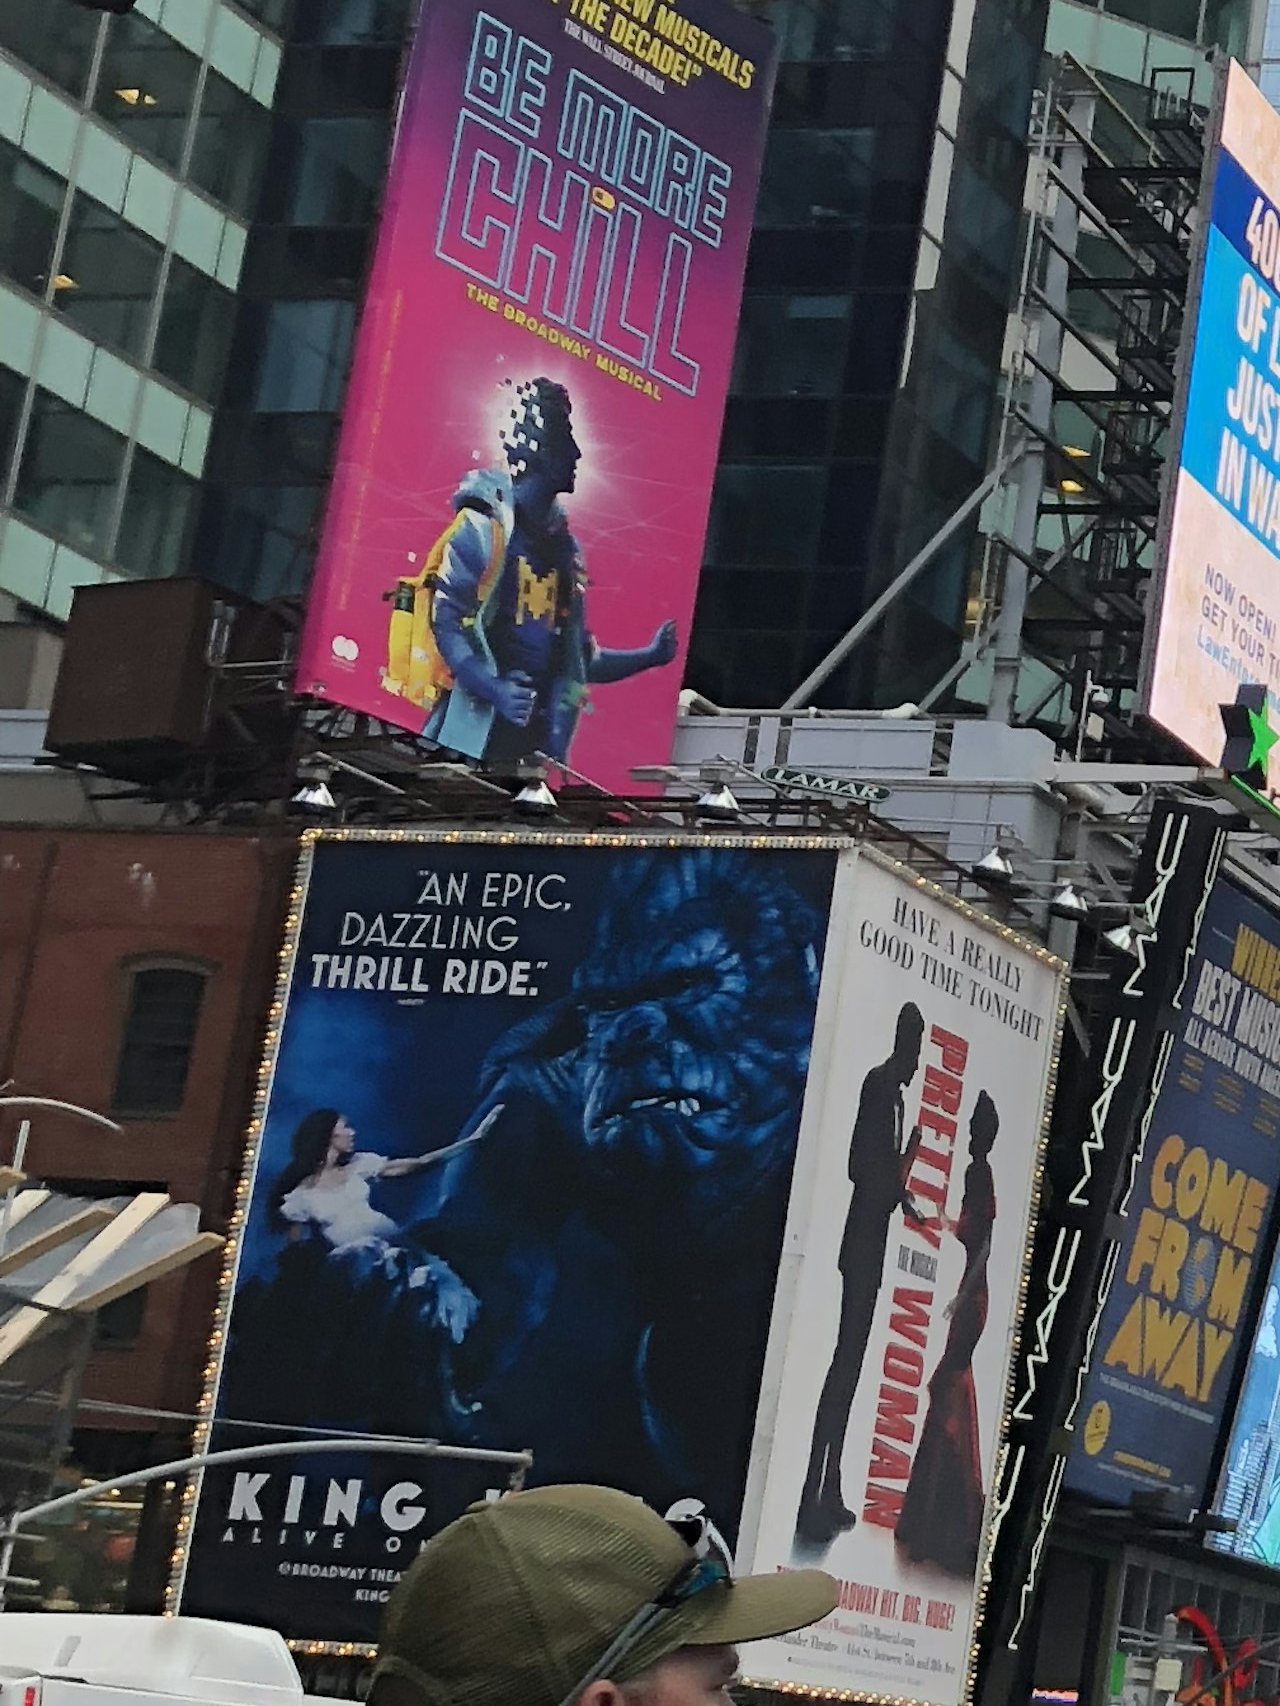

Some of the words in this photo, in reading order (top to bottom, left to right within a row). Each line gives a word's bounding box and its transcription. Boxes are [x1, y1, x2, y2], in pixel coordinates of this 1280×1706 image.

[654, 4, 754, 89] MUSICALS
[464, 11, 551, 137] BE
[558, 69, 731, 247] MORE
[466, 283, 499, 311] THE
[504, 303, 591, 360] BROADWAY
[594, 351, 662, 401] MUSICAL
[1236, 273, 1268, 355] OF
[1217, 427, 1247, 514] IN
[1202, 595, 1227, 631] GET
[1231, 622, 1265, 664] YOUR
[1205, 564, 1236, 605] NOW
[1239, 596, 1276, 639] OPEN!
[775, 769, 879, 799] LAMAR
[338, 911, 519, 952] DAZZLING
[481, 872, 572, 912] EPIC,
[311, 954, 429, 993] THRILL
[860, 920, 914, 970] GOOD
[920, 952, 964, 999] TIME
[969, 980, 1045, 1041] TONIGHT
[892, 897, 940, 947] HAVE
[944, 930, 955, 955] A
[961, 936, 1024, 993] REALLY
[1192, 959, 1242, 1032] BEST
[1184, 1017, 1203, 1048] ALL
[1201, 1026, 1236, 1068] ACROSS
[904, 1023, 969, 1250] PRETTY
[1151, 1134, 1269, 1254] COME
[1103, 1291, 1233, 1402] AWAY
[862, 1287, 934, 1530] WOMAN
[223, 1527, 344, 1549] ALIVE
[227, 1472, 426, 1531] KING
